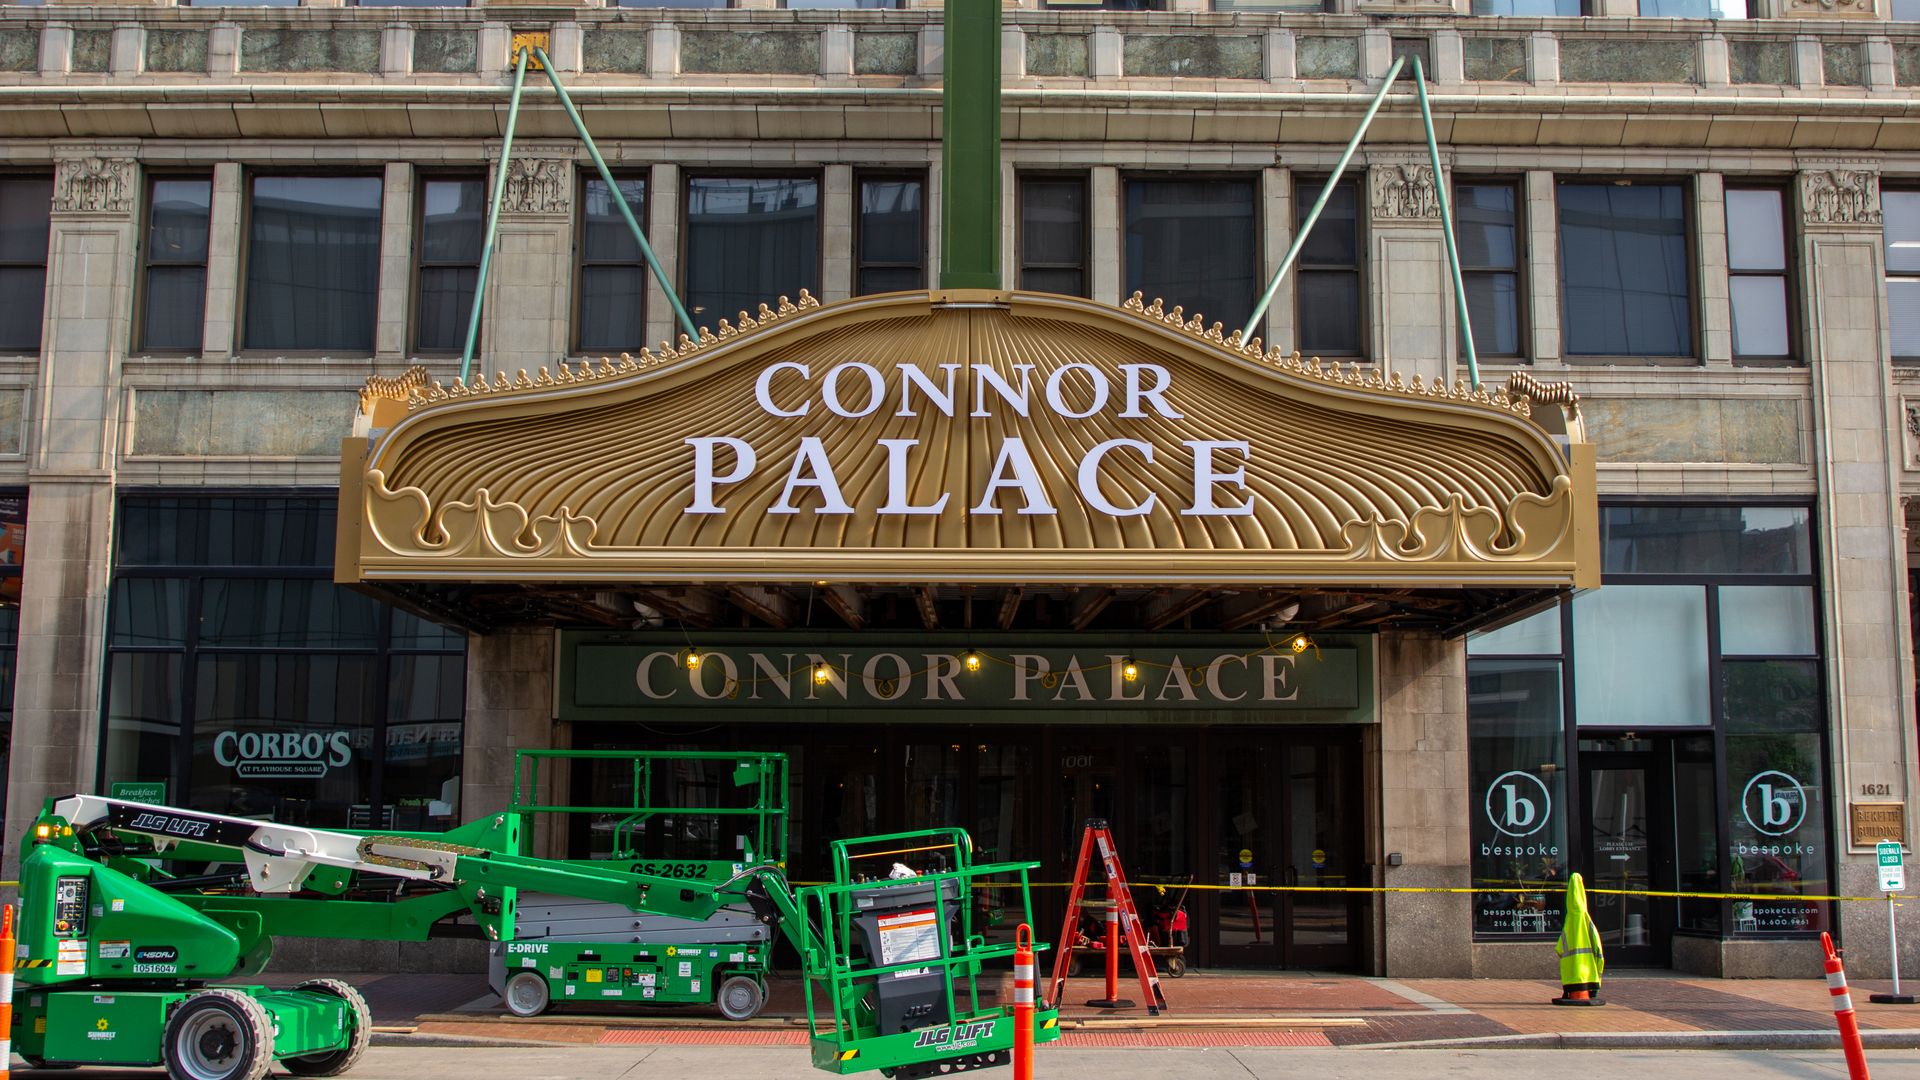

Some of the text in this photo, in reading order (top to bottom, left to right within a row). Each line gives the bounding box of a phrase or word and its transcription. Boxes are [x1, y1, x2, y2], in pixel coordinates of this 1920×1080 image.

[754, 361, 1186, 420] CONNOR
[683, 435, 1255, 517] PALACE
[636, 651, 1299, 701] CONNOR PALACE
[213, 731, 352, 767] CORBO'S
[119, 788, 157, 798] Breakfast
[1861, 784, 1890, 795] 1621
[1501, 784, 1535, 827] b
[1757, 783, 1791, 826] b
[130, 813, 210, 837] JLG LIFT
[1857, 826, 1900, 837] BUILDING
[1482, 843, 1558, 859] bespoke
[1739, 842, 1815, 857] bespoke
[1879, 847, 1900, 855] SIDEWALK
[1881, 855, 1899, 864] CLOSED
[630, 863, 708, 878] GS-2632
[508, 943, 549, 953] E-DRIVE
[135, 964, 176, 973] 10516047
[914, 1021, 996, 1048] JLG LIFT
